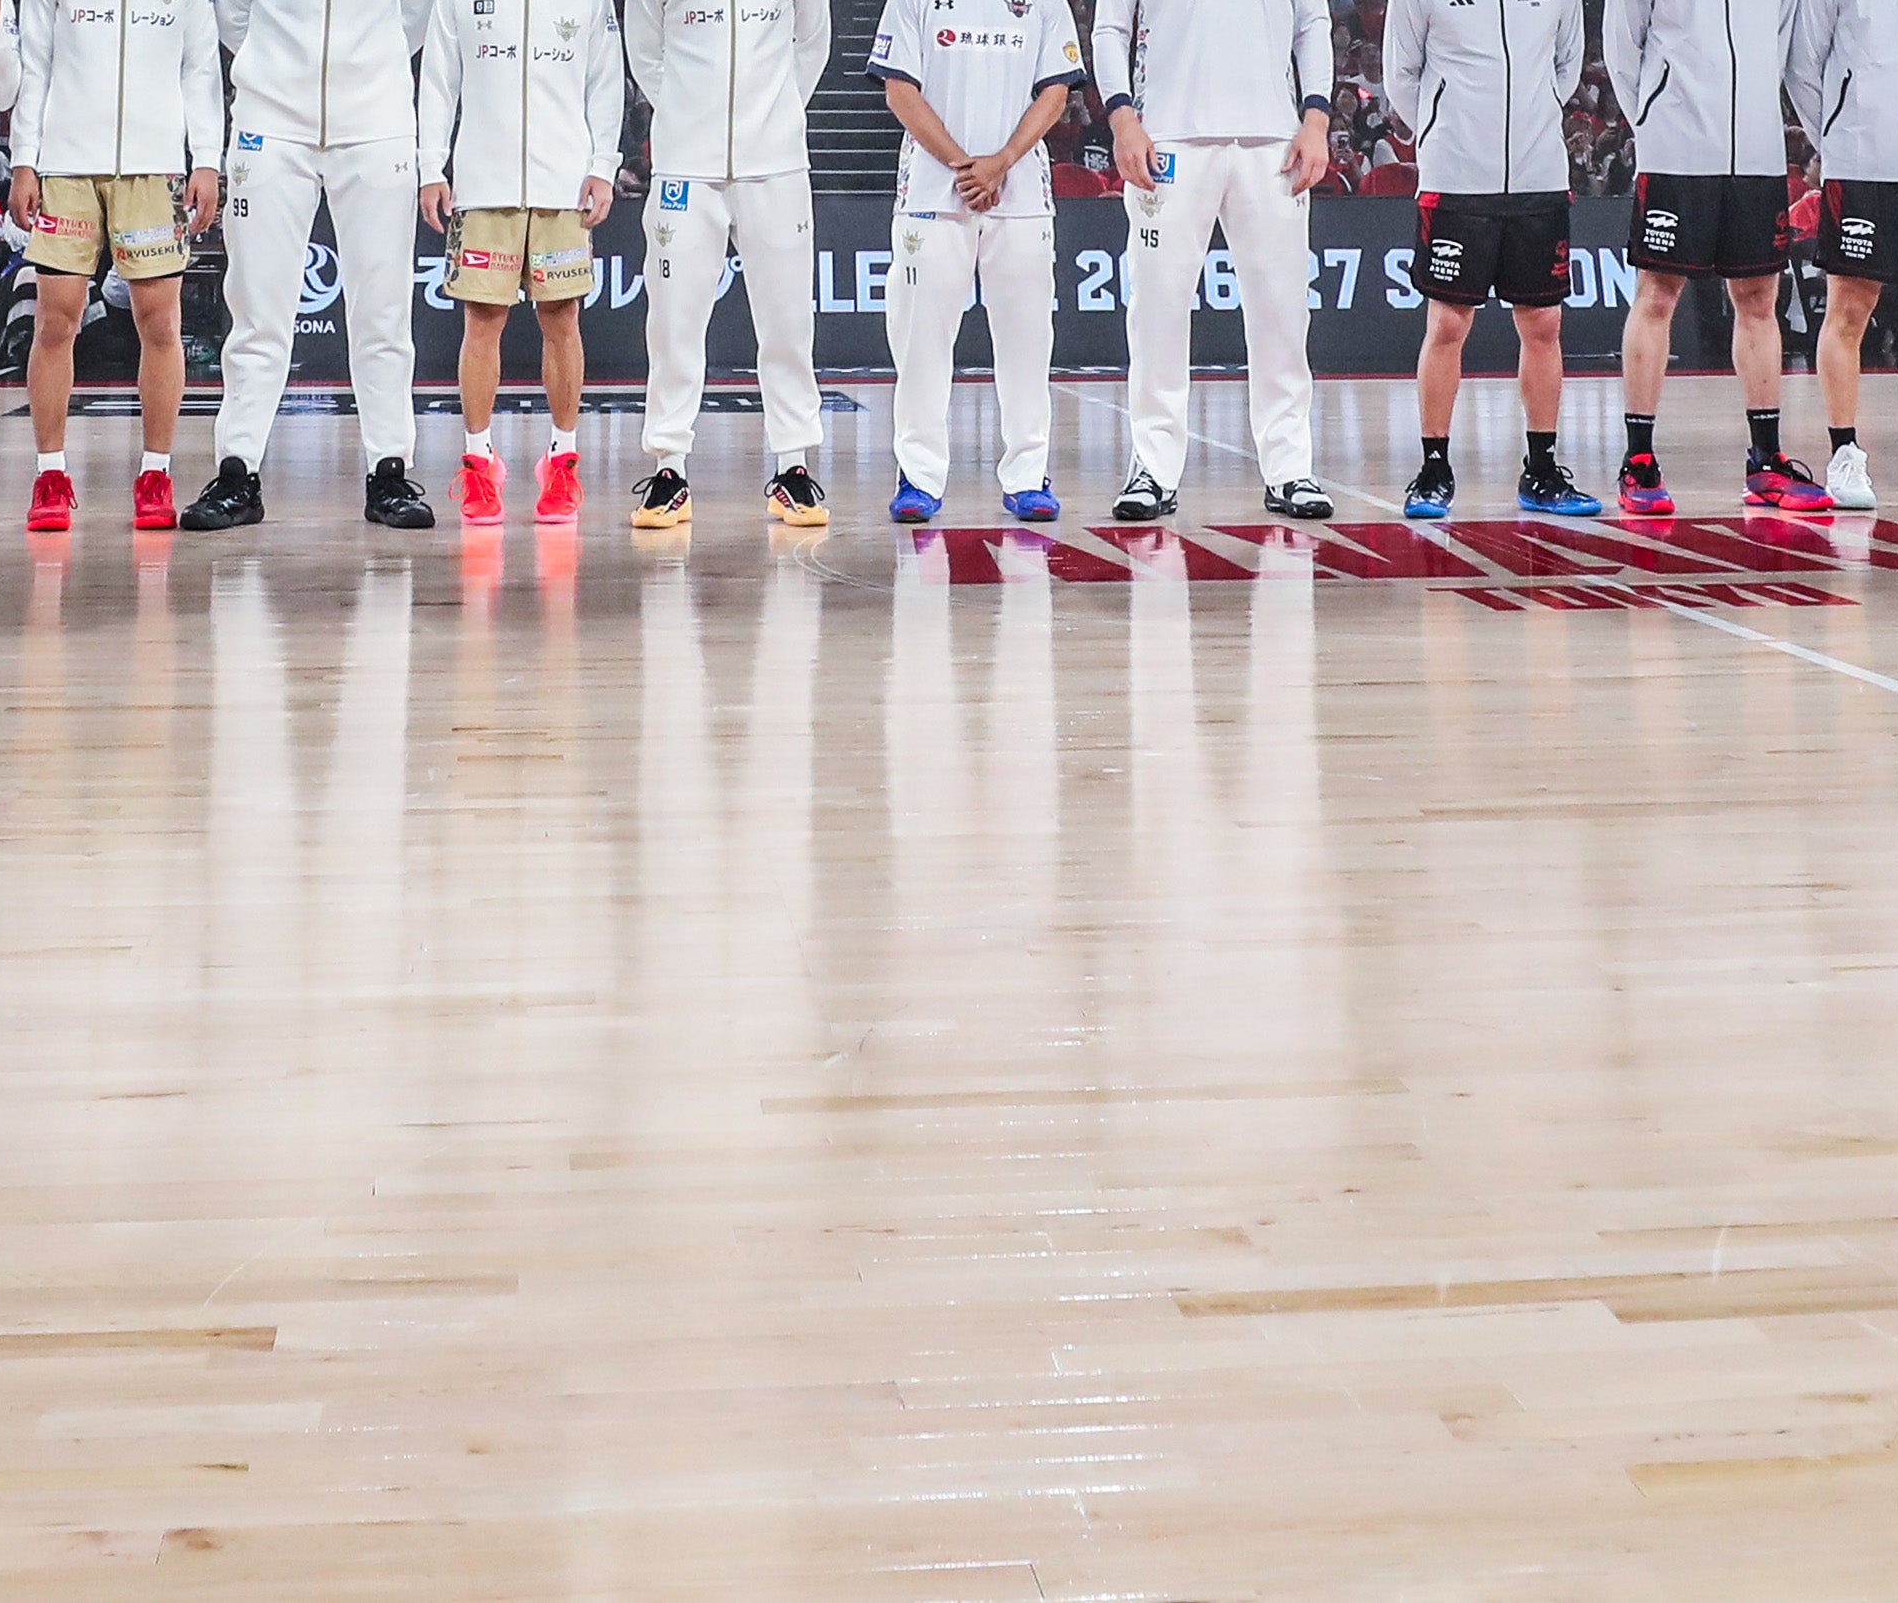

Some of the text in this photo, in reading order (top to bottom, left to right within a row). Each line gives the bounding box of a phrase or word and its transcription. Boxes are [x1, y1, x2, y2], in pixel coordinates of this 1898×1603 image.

[959, 31, 1024, 49] 琉球銀行
[233, 198, 249, 218] 99
[1140, 228, 1159, 248] 45
[125, 244, 175, 259] RYUSEKI
[658, 258, 671, 279] 18
[905, 266, 918, 285] 11
[293, 320, 336, 334] SONA
[1425, 582, 1862, 612] TOKYO
